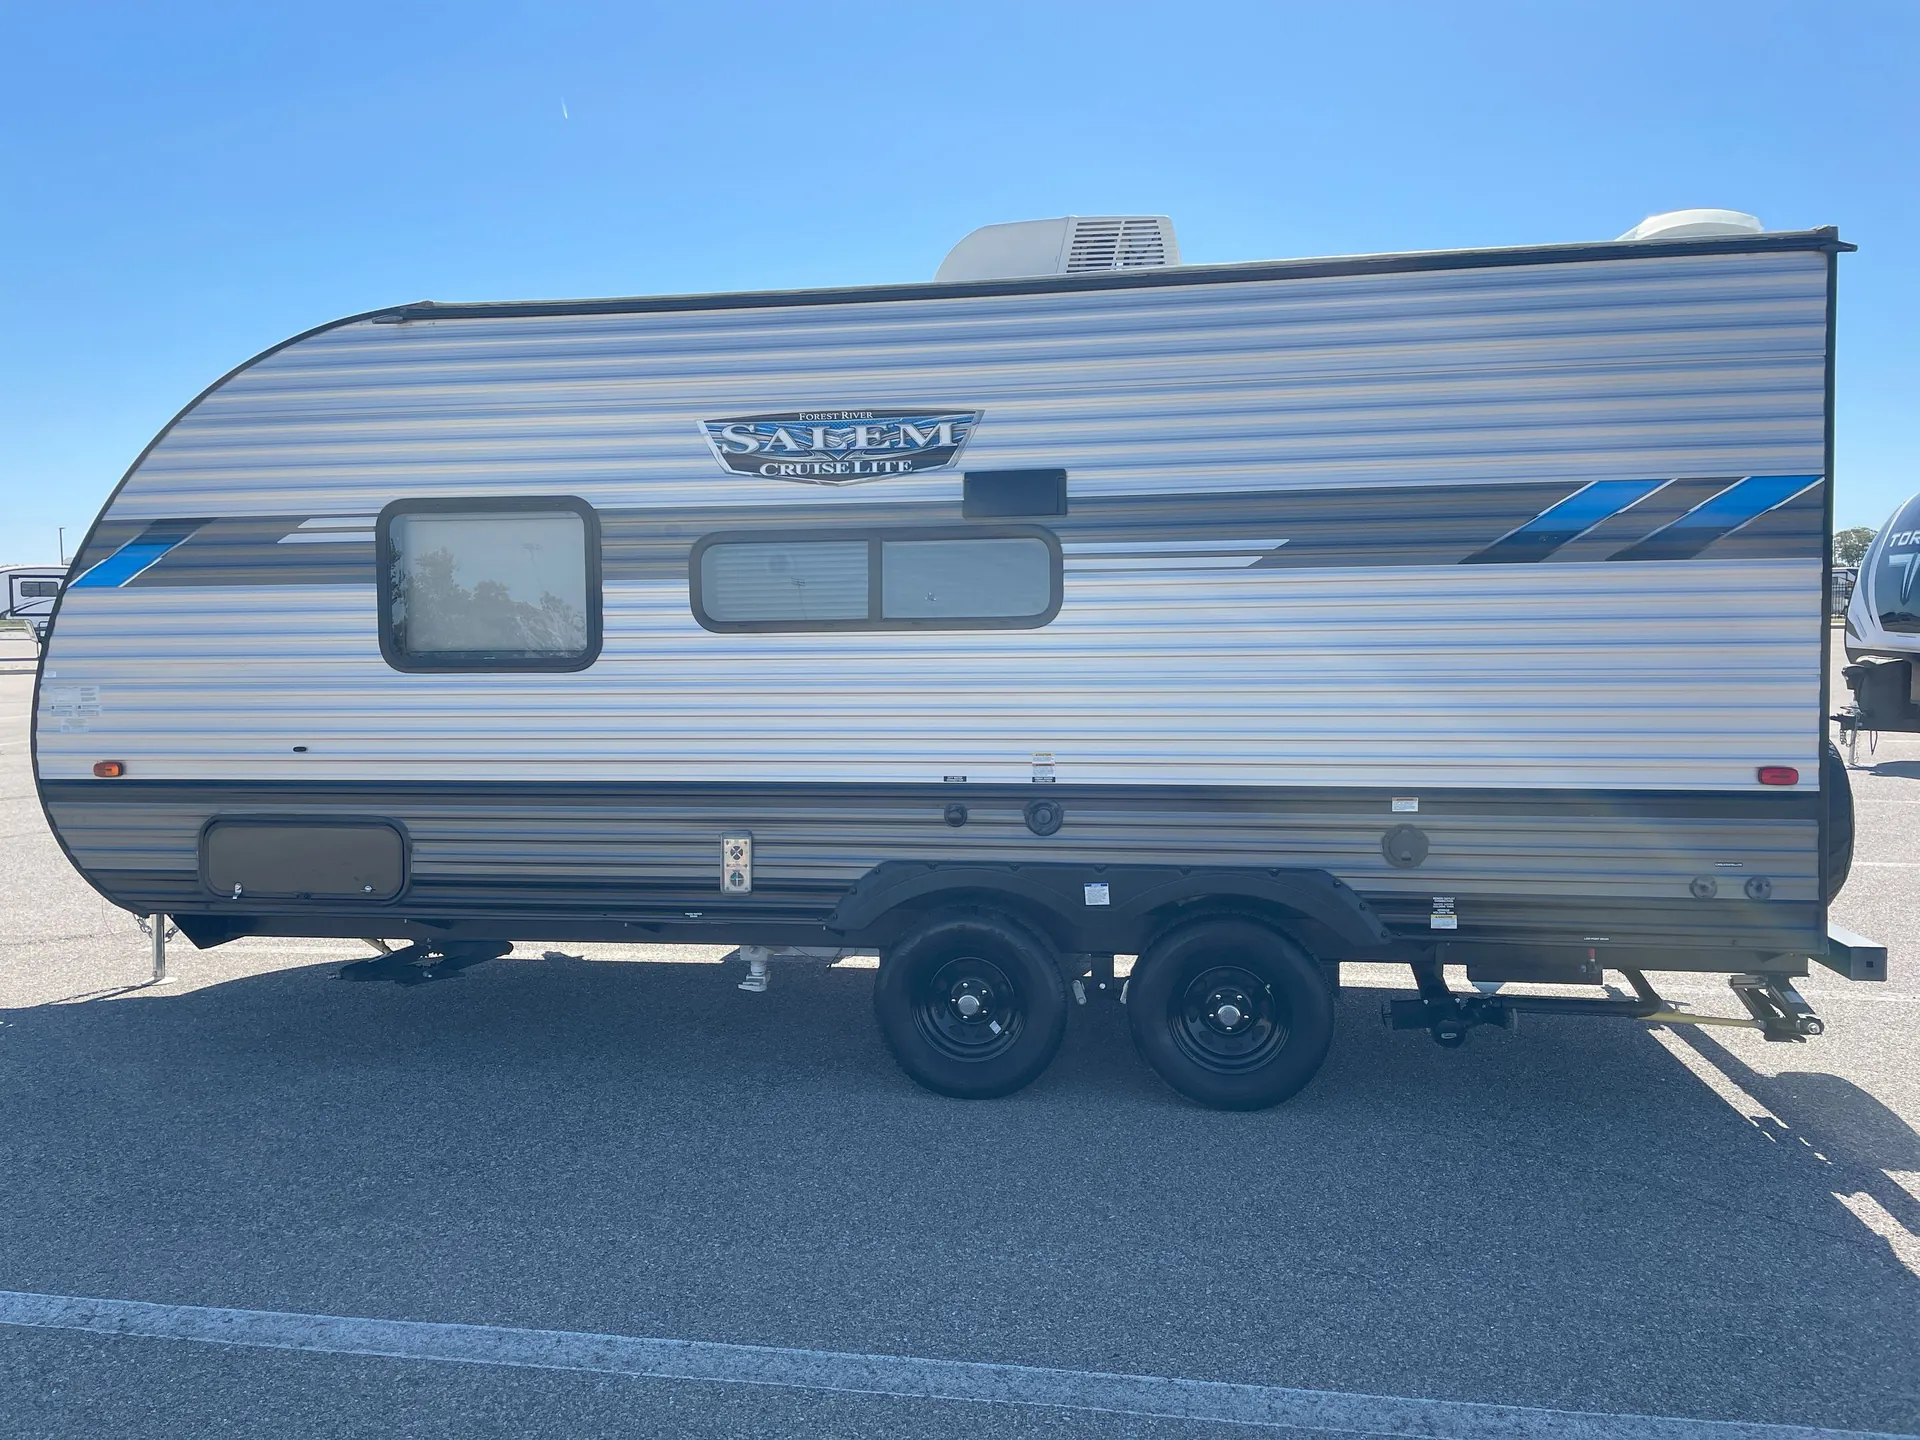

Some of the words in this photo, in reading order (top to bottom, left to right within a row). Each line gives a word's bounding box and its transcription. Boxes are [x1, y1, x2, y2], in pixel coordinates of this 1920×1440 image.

[799, 412, 839, 421] FOREST
[841, 411, 873, 419] RIVER
[721, 421, 959, 454] SALEM
